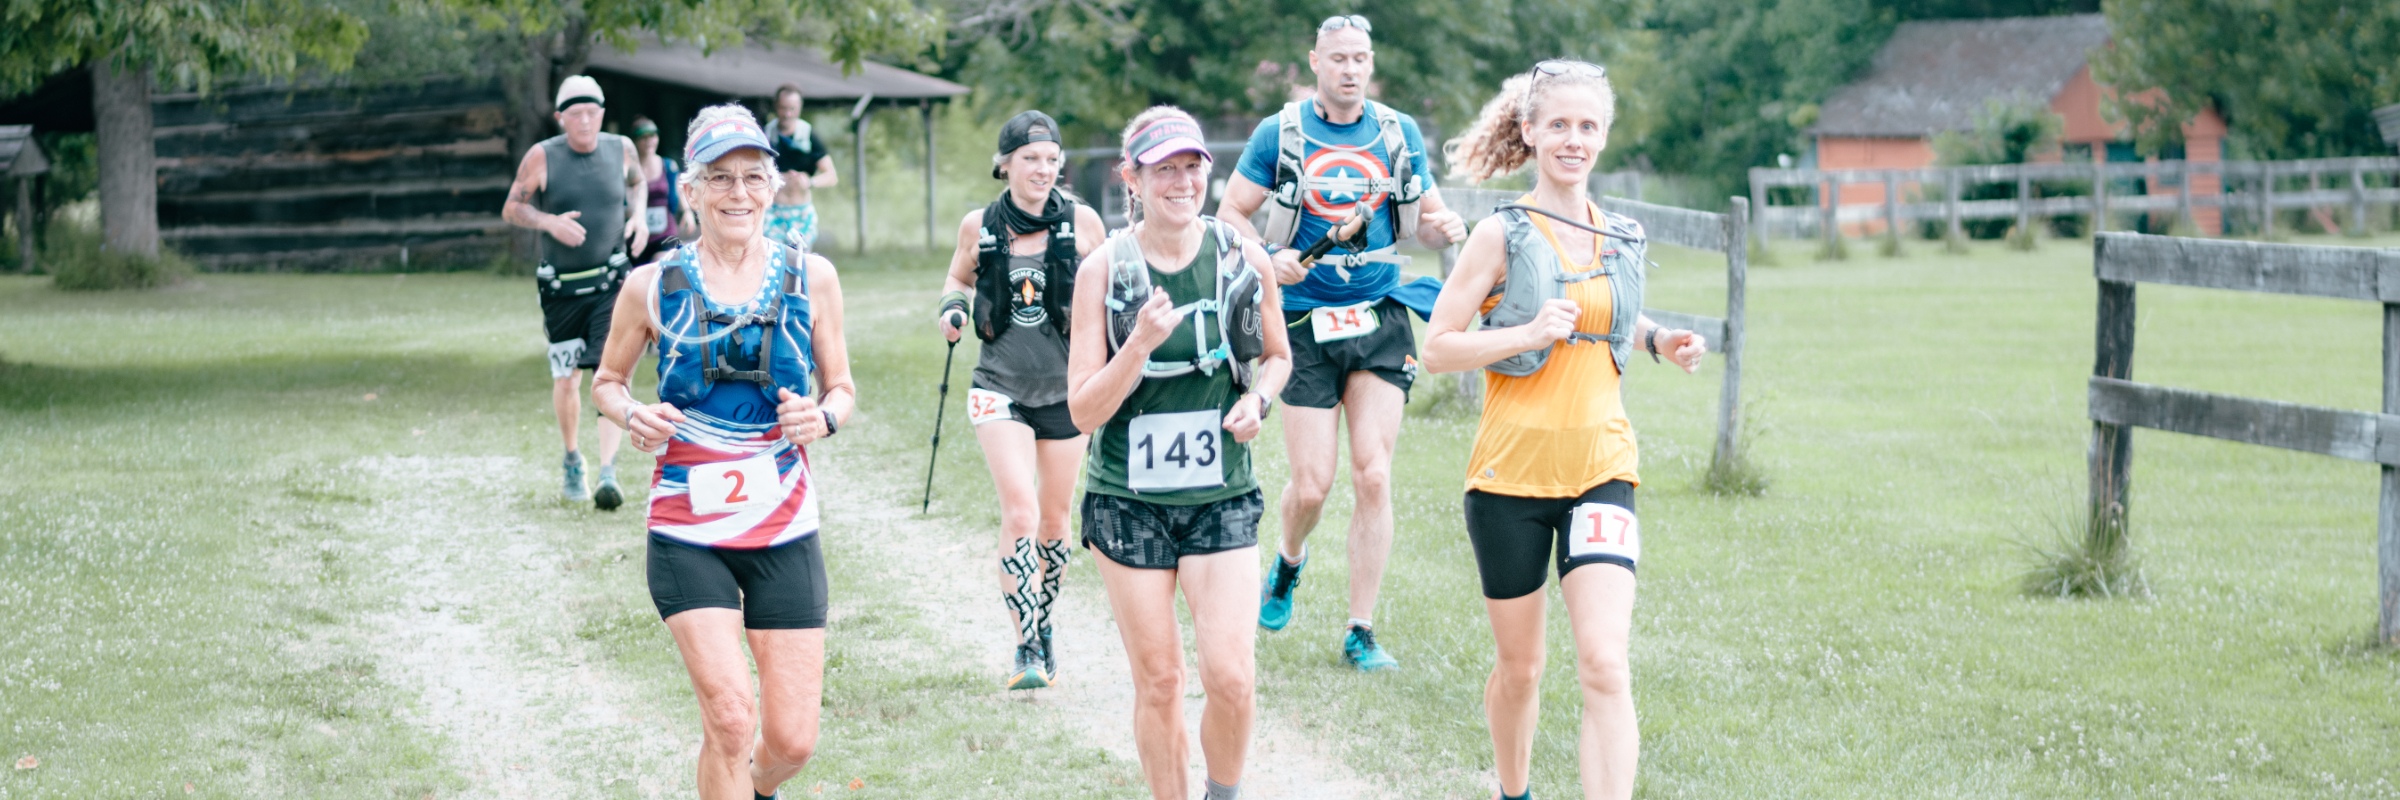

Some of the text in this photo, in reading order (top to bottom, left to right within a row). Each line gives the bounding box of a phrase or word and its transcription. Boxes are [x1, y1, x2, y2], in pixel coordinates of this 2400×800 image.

[1326, 308, 1361, 332] 14
[972, 394, 996, 418] 32
[1138, 429, 1216, 470] 143
[722, 470, 749, 504] 2
[1587, 511, 1630, 546] 17
